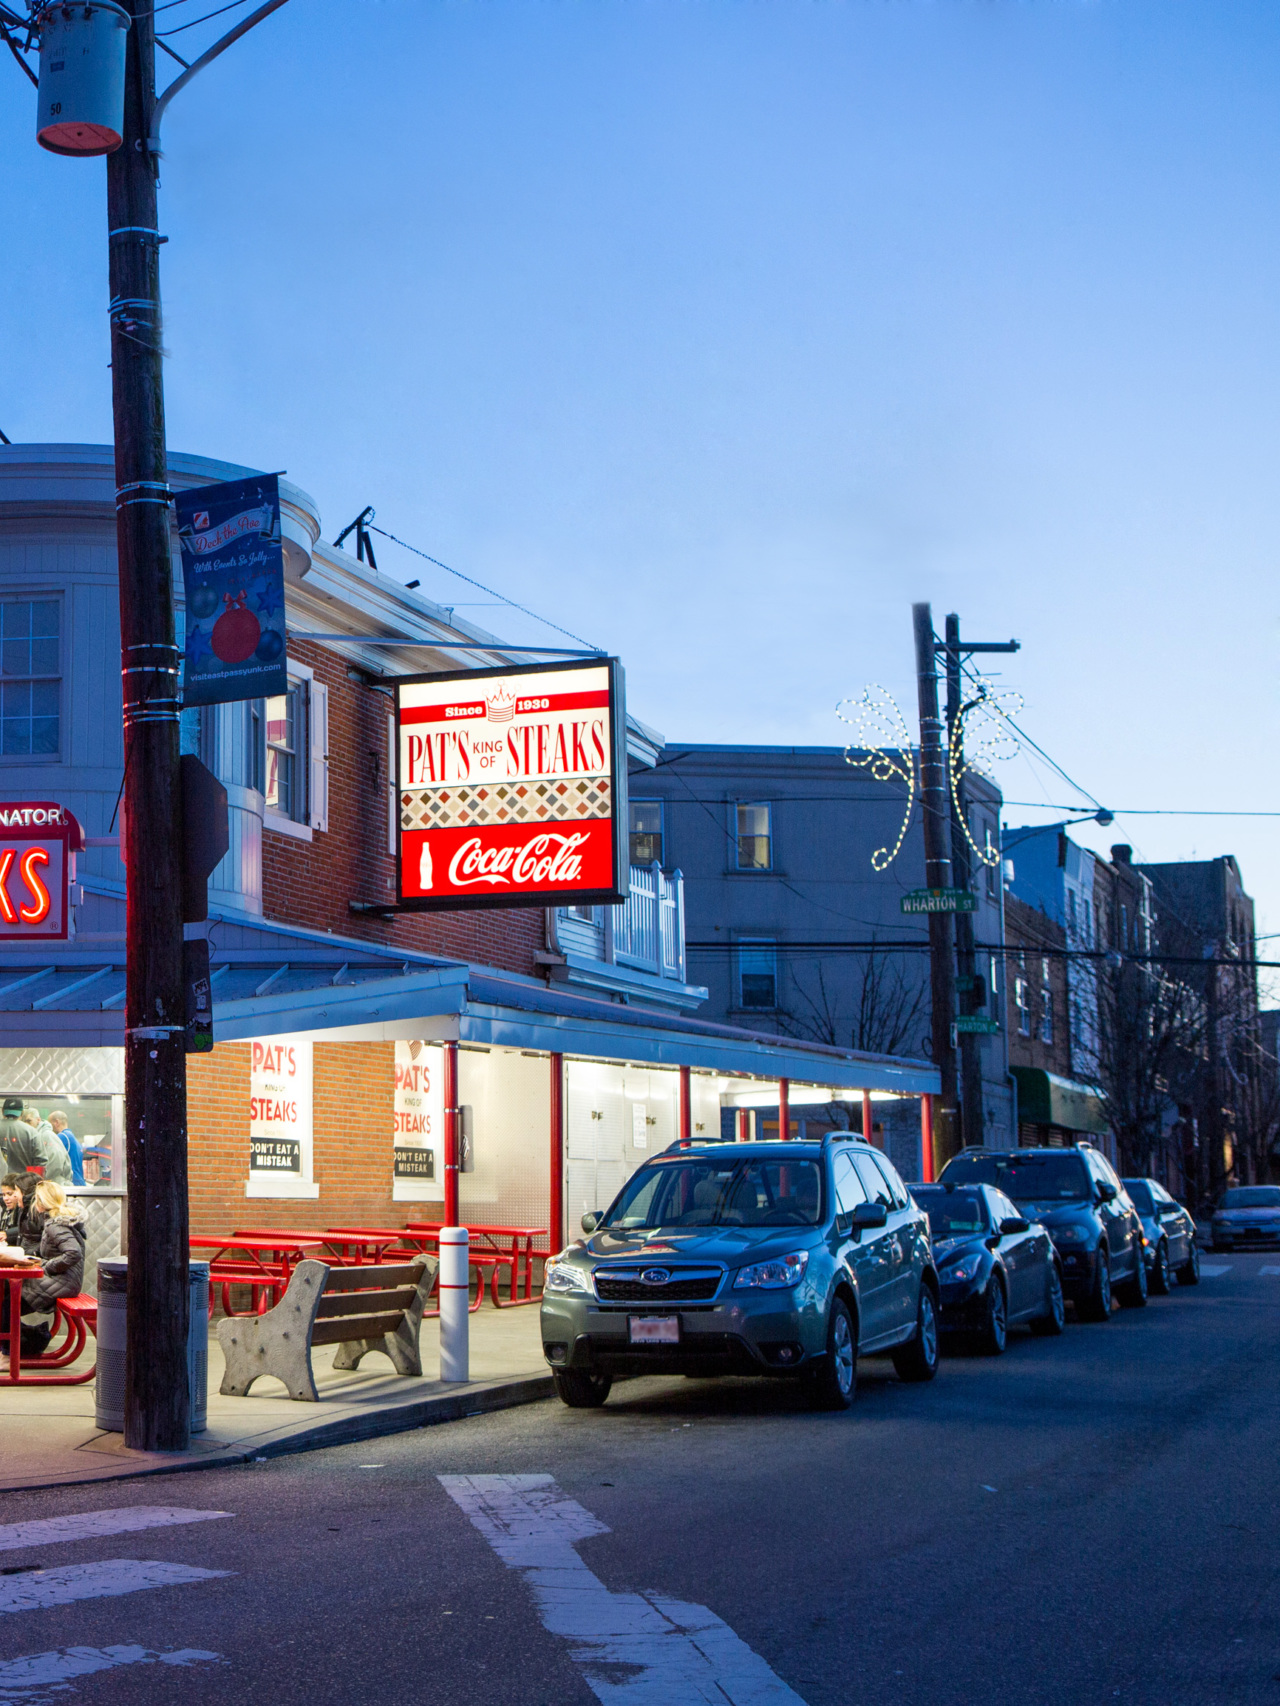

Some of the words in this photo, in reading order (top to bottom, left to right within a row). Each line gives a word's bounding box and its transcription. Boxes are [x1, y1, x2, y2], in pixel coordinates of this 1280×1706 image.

[50, 102, 61, 116] 50
[196, 531, 223, 552] Deck
[221, 524, 238, 540] the
[238, 516, 260, 531] Ave
[194, 560, 212, 573] With
[214, 556, 236, 571] Events
[238, 554, 247, 566] So
[190, 664, 281, 681] visiteastpassyunk.com
[445, 706, 483, 718] Since
[517, 698, 550, 711] 1930
[407, 730, 470, 785] PAT'S
[472, 740, 503, 754] KING
[506, 719, 605, 778] STEAKS
[479, 756, 496, 769] OF
[448, 832, 591, 886] Coca-Cola
[903, 896, 956, 912] WHARTON
[963, 900, 972, 909] ST
[958, 1022, 988, 1032] HARTON
[253, 1042, 296, 1077] PAT'S
[394, 1063, 430, 1093] PAT'S
[250, 1097, 298, 1123] STEAKS
[405, 1098, 415, 1106] KING
[394, 1112, 431, 1134] STEAKS
[250, 1142, 274, 1154] DON'T
[276, 1144, 292, 1154] EAT
[294, 1145, 299, 1155] A
[256, 1155, 292, 1166] MISTEAK
[414, 1153, 427, 1162] EAT
[428, 1154, 433, 1163] A
[399, 1163, 427, 1172] MISTEAK
